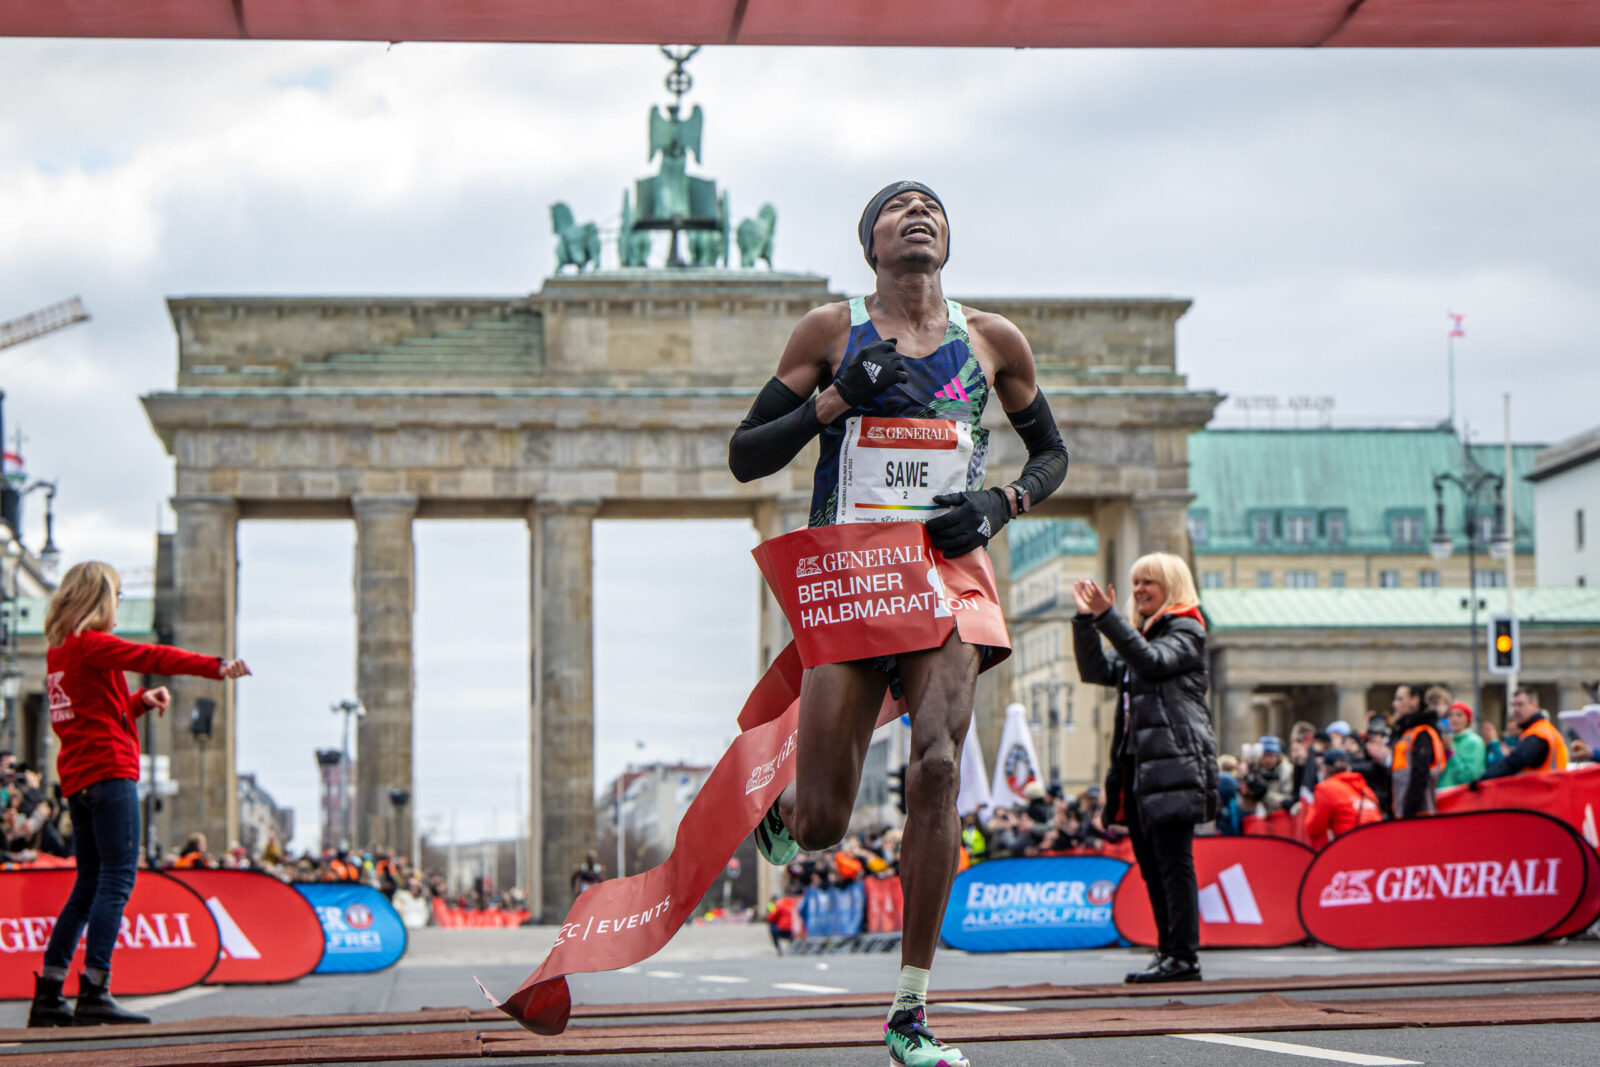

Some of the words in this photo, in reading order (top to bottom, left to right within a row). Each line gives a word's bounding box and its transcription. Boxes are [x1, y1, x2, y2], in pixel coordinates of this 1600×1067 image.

[886, 427, 950, 440] GENERALI
[885, 460, 929, 488] SAWE
[902, 490, 908, 500] 2
[822, 545, 925, 573] GENERALI
[798, 572, 904, 605] BERLINER
[800, 591, 980, 629] HALBMARATHON
[1376, 857, 1562, 903] GENERALI
[966, 881, 1086, 909] ERDINGER
[596, 894, 671, 934] EVENTS
[961, 907, 1112, 926] ALKOHOLFREI
[0, 912, 196, 954] GERALI
